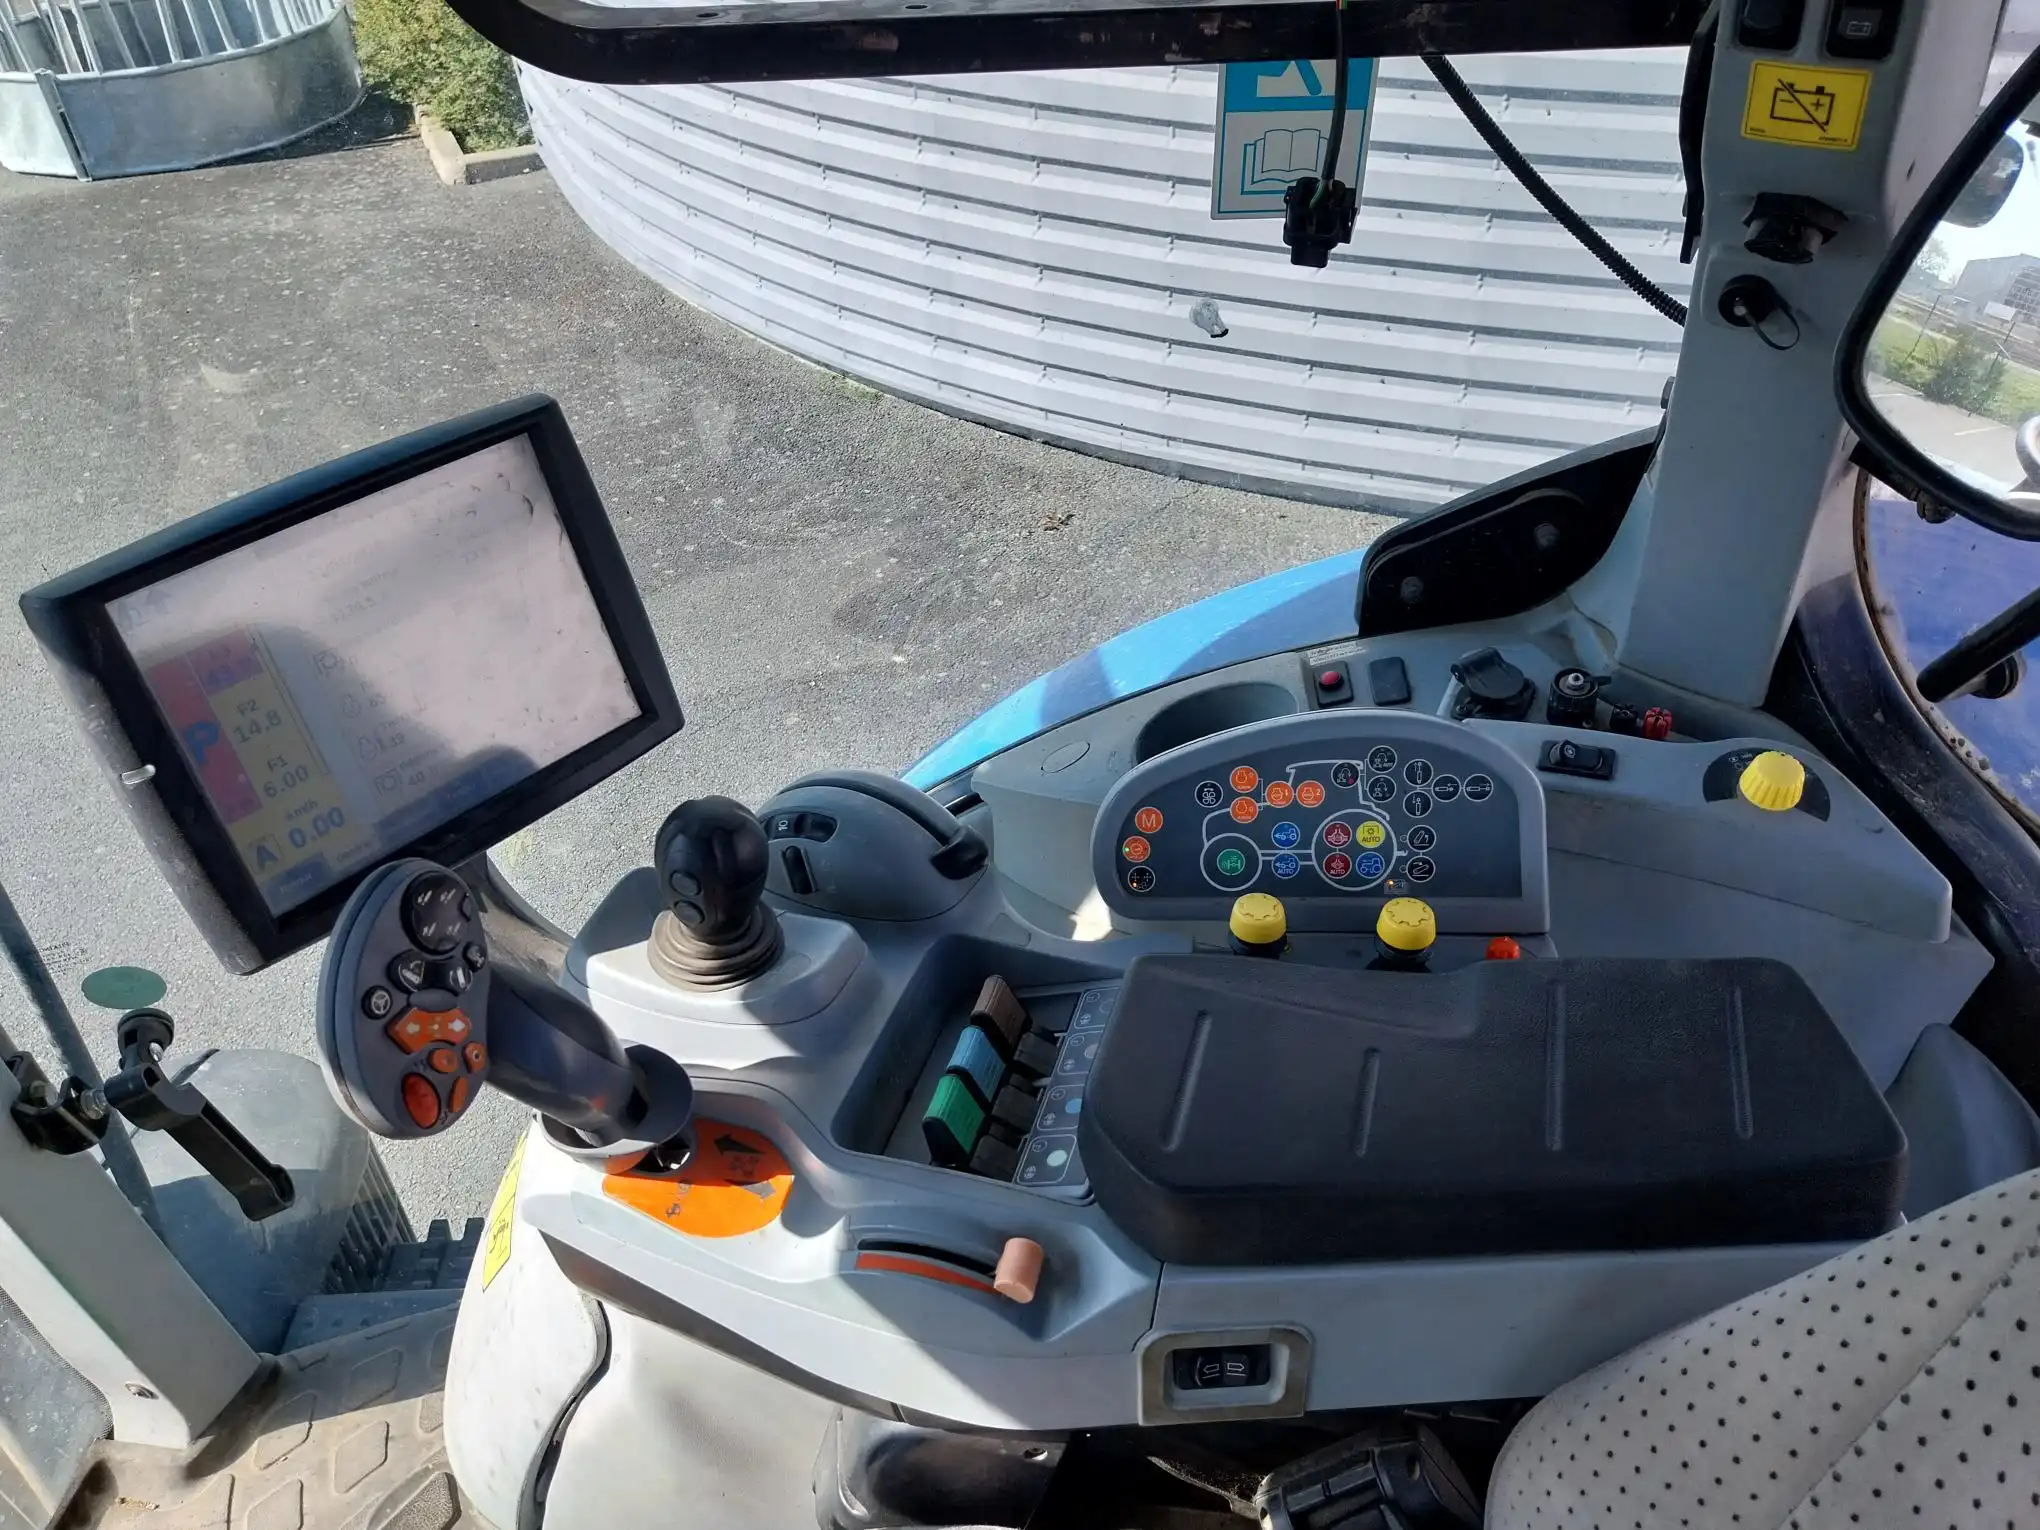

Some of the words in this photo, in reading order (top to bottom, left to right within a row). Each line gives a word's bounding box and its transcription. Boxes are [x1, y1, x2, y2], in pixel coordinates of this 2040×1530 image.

[236, 698, 260, 716] F2
[233, 709, 283, 744] 14.8
[184, 719, 221, 765] P
[267, 754, 288, 773] F1
[263, 765, 309, 798] 6.00
[288, 806, 345, 849] 0.00
[1141, 813, 1156, 828] M
[256, 843, 279, 871] A
